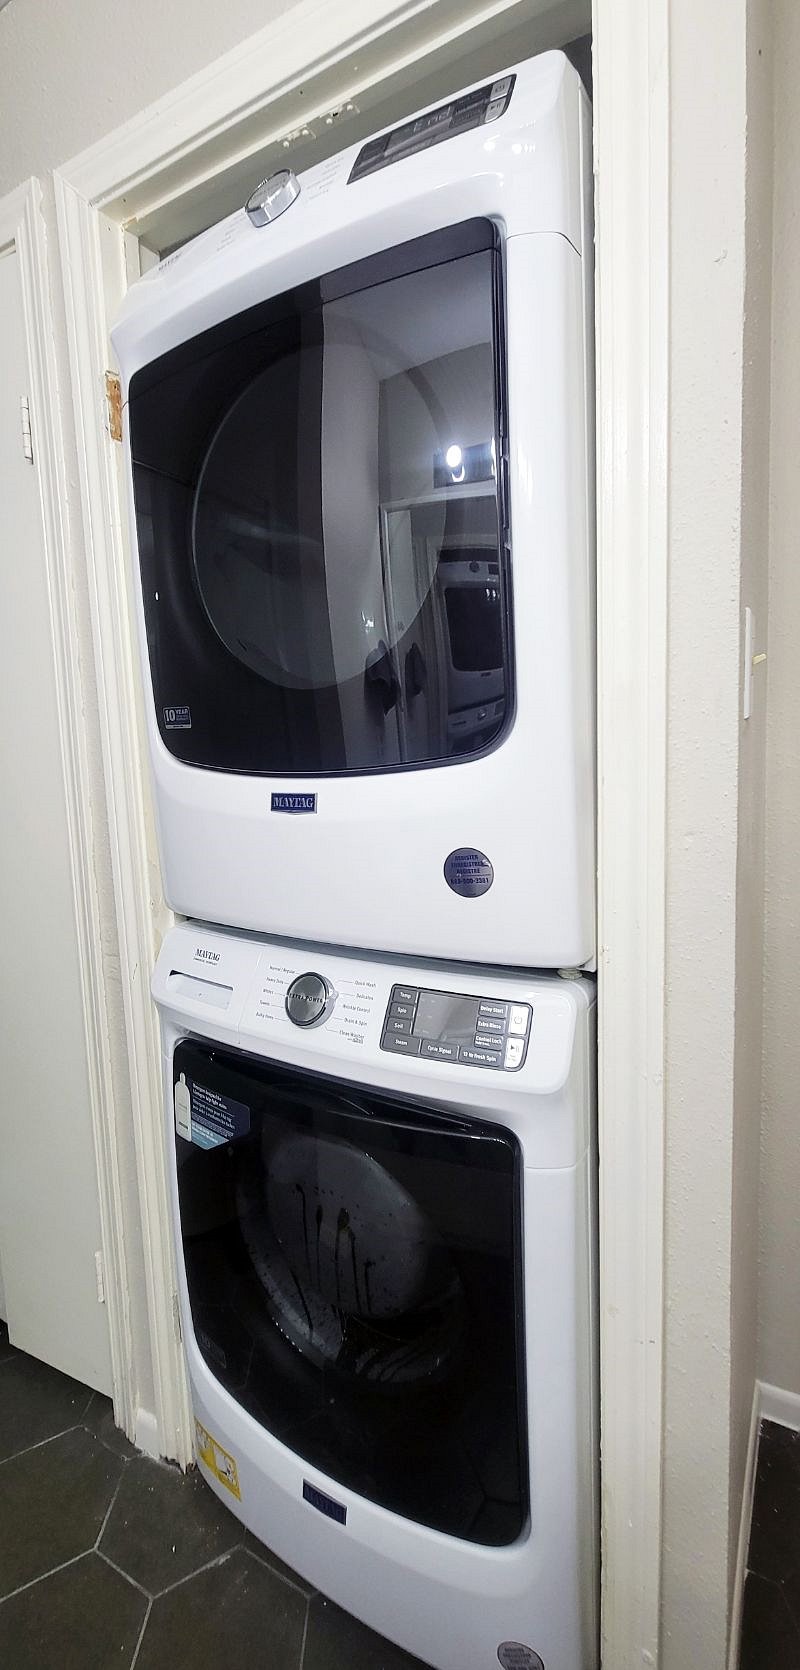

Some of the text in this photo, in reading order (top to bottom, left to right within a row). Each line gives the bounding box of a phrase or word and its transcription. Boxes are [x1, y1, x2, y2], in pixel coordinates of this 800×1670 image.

[165, 709, 176, 722] 10
[273, 797, 314, 808] MAYTAG
[194, 948, 221, 962] MAYTAG
[400, 991, 412, 999] Temp
[397, 1006, 407, 1014] Spin
[480, 1005, 504, 1014] Delay Start
[477, 1020, 489, 1028] Extra
[395, 1038, 408, 1046] Steam
[475, 1035, 492, 1043] Control
[427, 1044, 452, 1055] Cycle Signal
